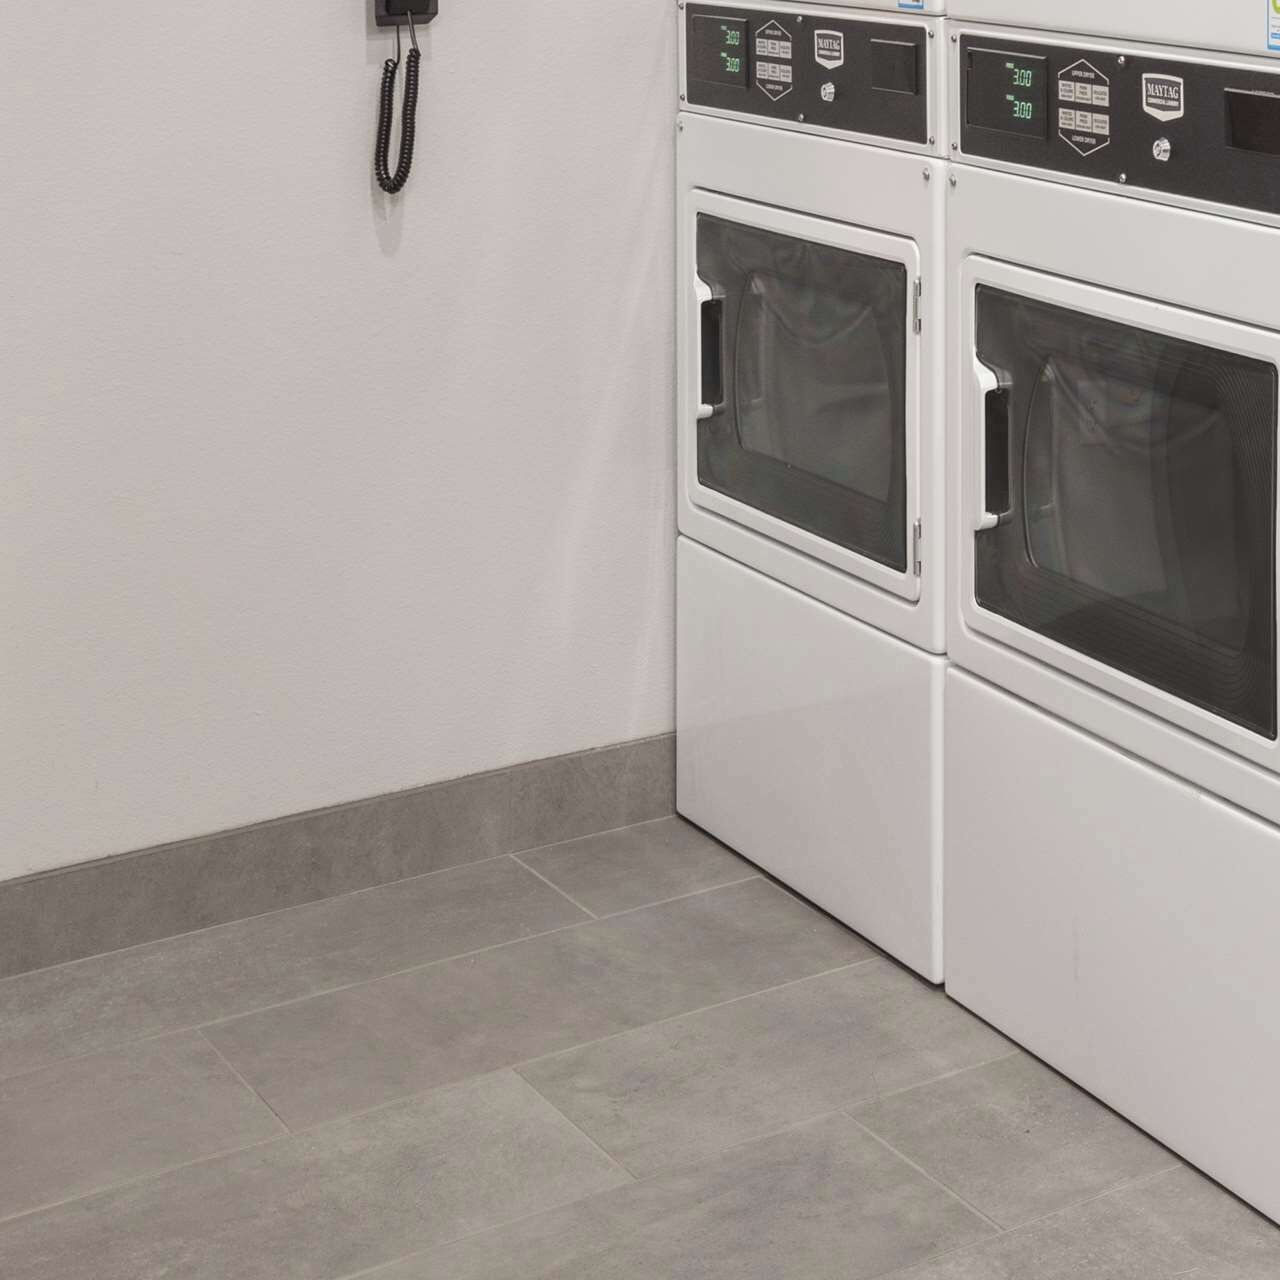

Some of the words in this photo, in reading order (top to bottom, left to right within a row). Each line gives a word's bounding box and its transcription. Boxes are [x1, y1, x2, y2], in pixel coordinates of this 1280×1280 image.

[817, 38, 841, 50] MAYTAG
[1013, 69, 1032, 87] 3.00
[1147, 83, 1179, 99] MAYTAG
[1013, 101, 1032, 119] 3.00
